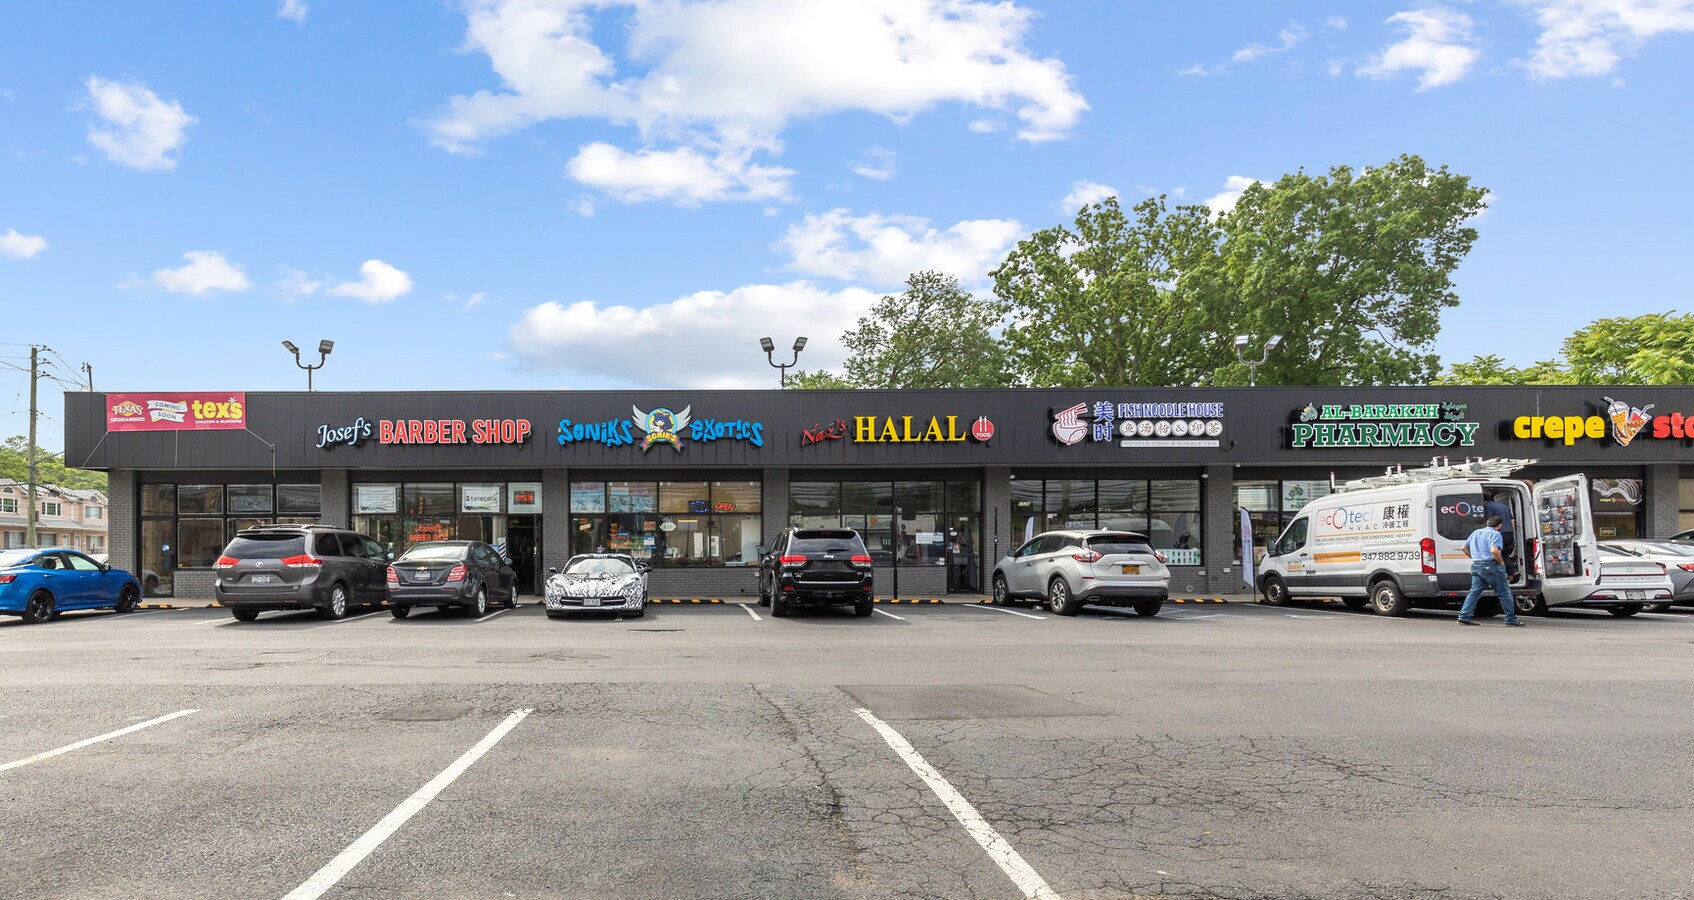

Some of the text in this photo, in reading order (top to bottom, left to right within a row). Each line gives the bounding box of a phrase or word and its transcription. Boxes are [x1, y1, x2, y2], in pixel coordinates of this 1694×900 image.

[112, 403, 143, 415] TEXAS
[154, 401, 181, 410] COMING
[191, 400, 243, 419] texs
[1118, 402, 1223, 418] FISH NOODLE HOUSE
[1320, 404, 1439, 420] AL-BARAKAH
[158, 411, 177, 420] SOON
[1093, 401, 1114, 441] 美时
[316, 417, 531, 448] Josef's BARBER SHOP
[801, 415, 967, 446] Naz's HALAL
[1292, 422, 1479, 448] PHARMACY
[1513, 415, 1605, 446] crepe
[714, 502, 734, 511] OPEN
[1065, 521, 1084, 529] OPEN
[1361, 551, 1421, 562] 347.882.9739
